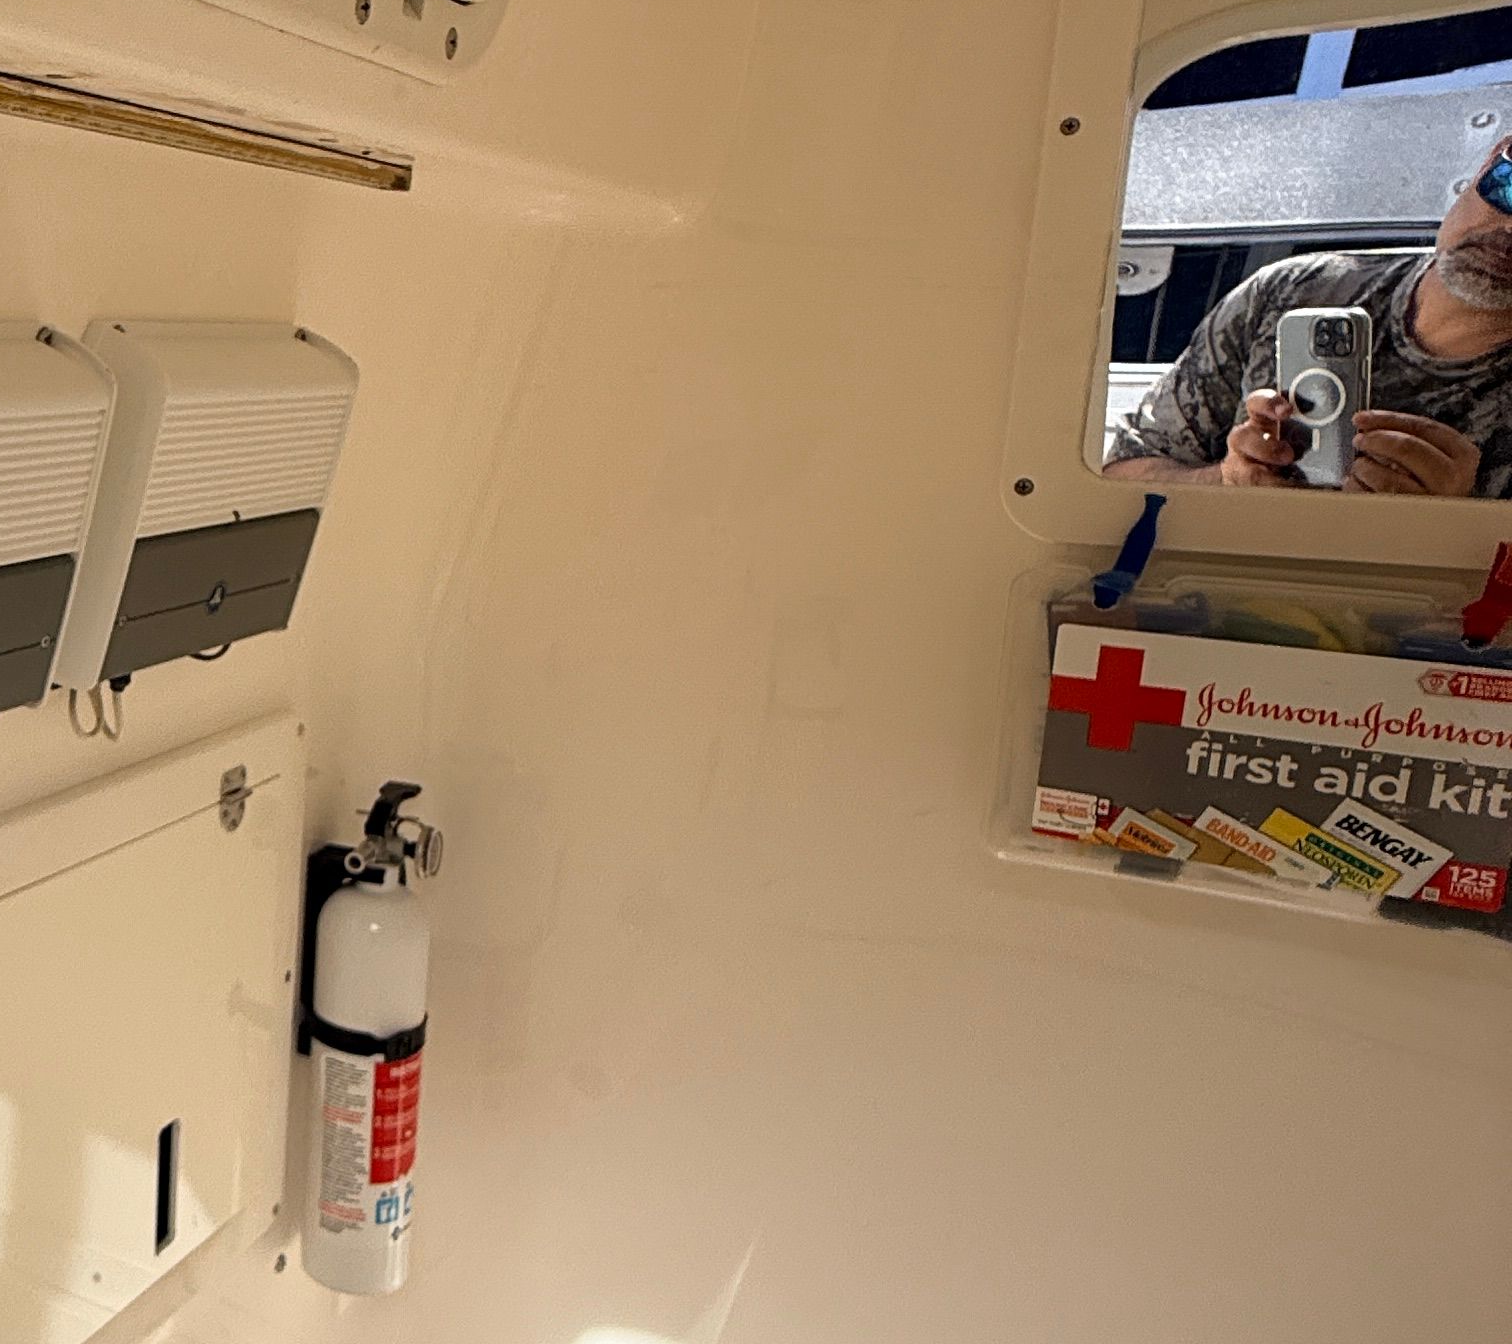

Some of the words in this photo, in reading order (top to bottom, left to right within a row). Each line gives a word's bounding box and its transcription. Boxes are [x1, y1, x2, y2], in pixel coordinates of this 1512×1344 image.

[1196, 682, 1342, 726] Johnson
[1186, 739, 1298, 788] first
[1313, 762, 1413, 805] aid
[1429, 769, 1512, 819] kit
[1200, 730, 1265, 748] ALL
[1311, 745, 1510, 780] PURPOSE
[1335, 813, 1434, 868] BENGAY
[1449, 866, 1498, 888] 125
